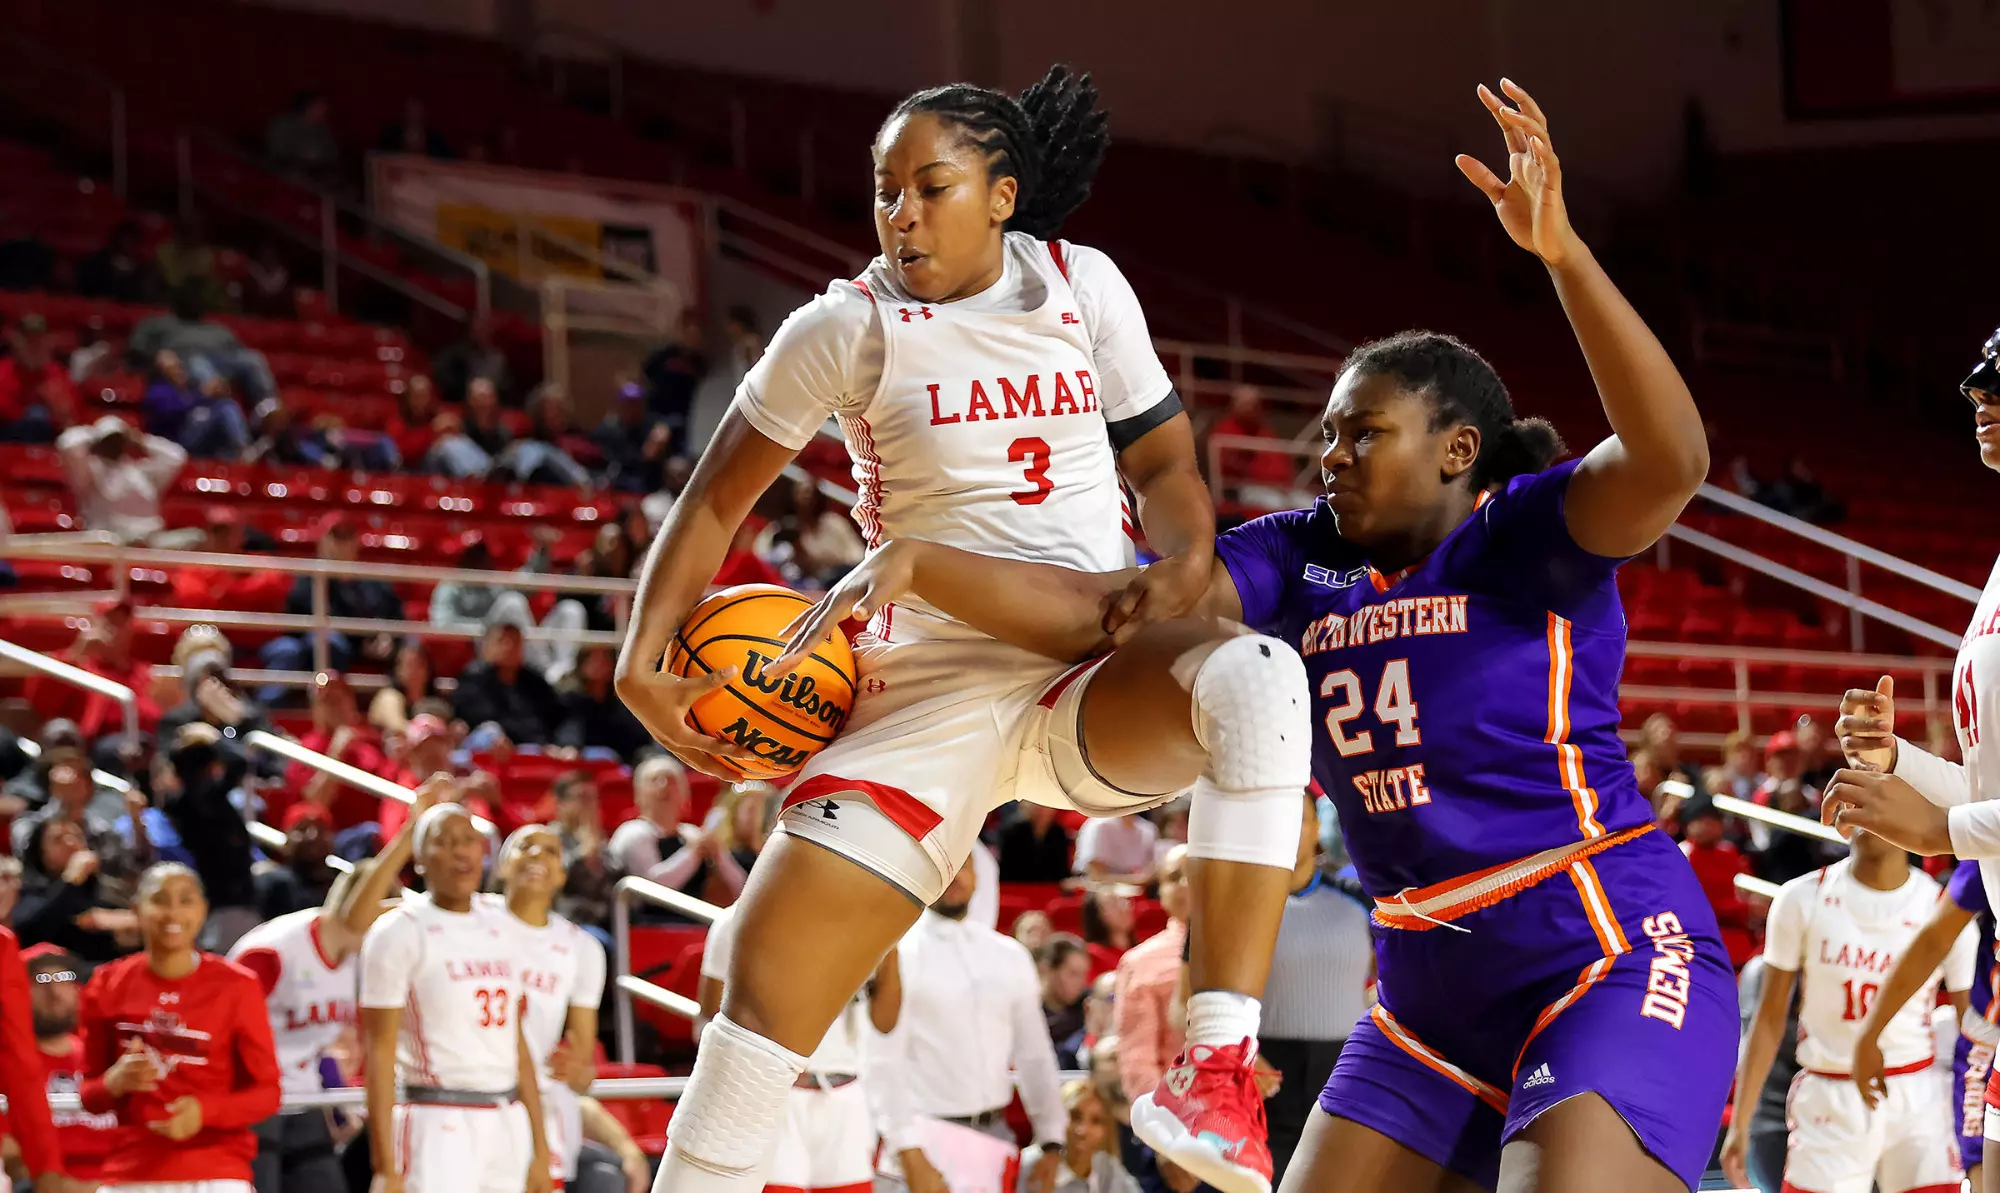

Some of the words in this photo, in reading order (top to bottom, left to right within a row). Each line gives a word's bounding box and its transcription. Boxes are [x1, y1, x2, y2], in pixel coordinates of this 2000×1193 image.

[926, 370, 1098, 426] LAMAR
[1007, 437, 1055, 505] 3
[742, 649, 846, 732] Wilson
[1320, 657, 1422, 758] 24
[721, 716, 811, 767] NCAA
[1352, 763, 1432, 814] STATE
[475, 987, 507, 1028] 33
[1523, 1076, 1556, 1090] adidas
